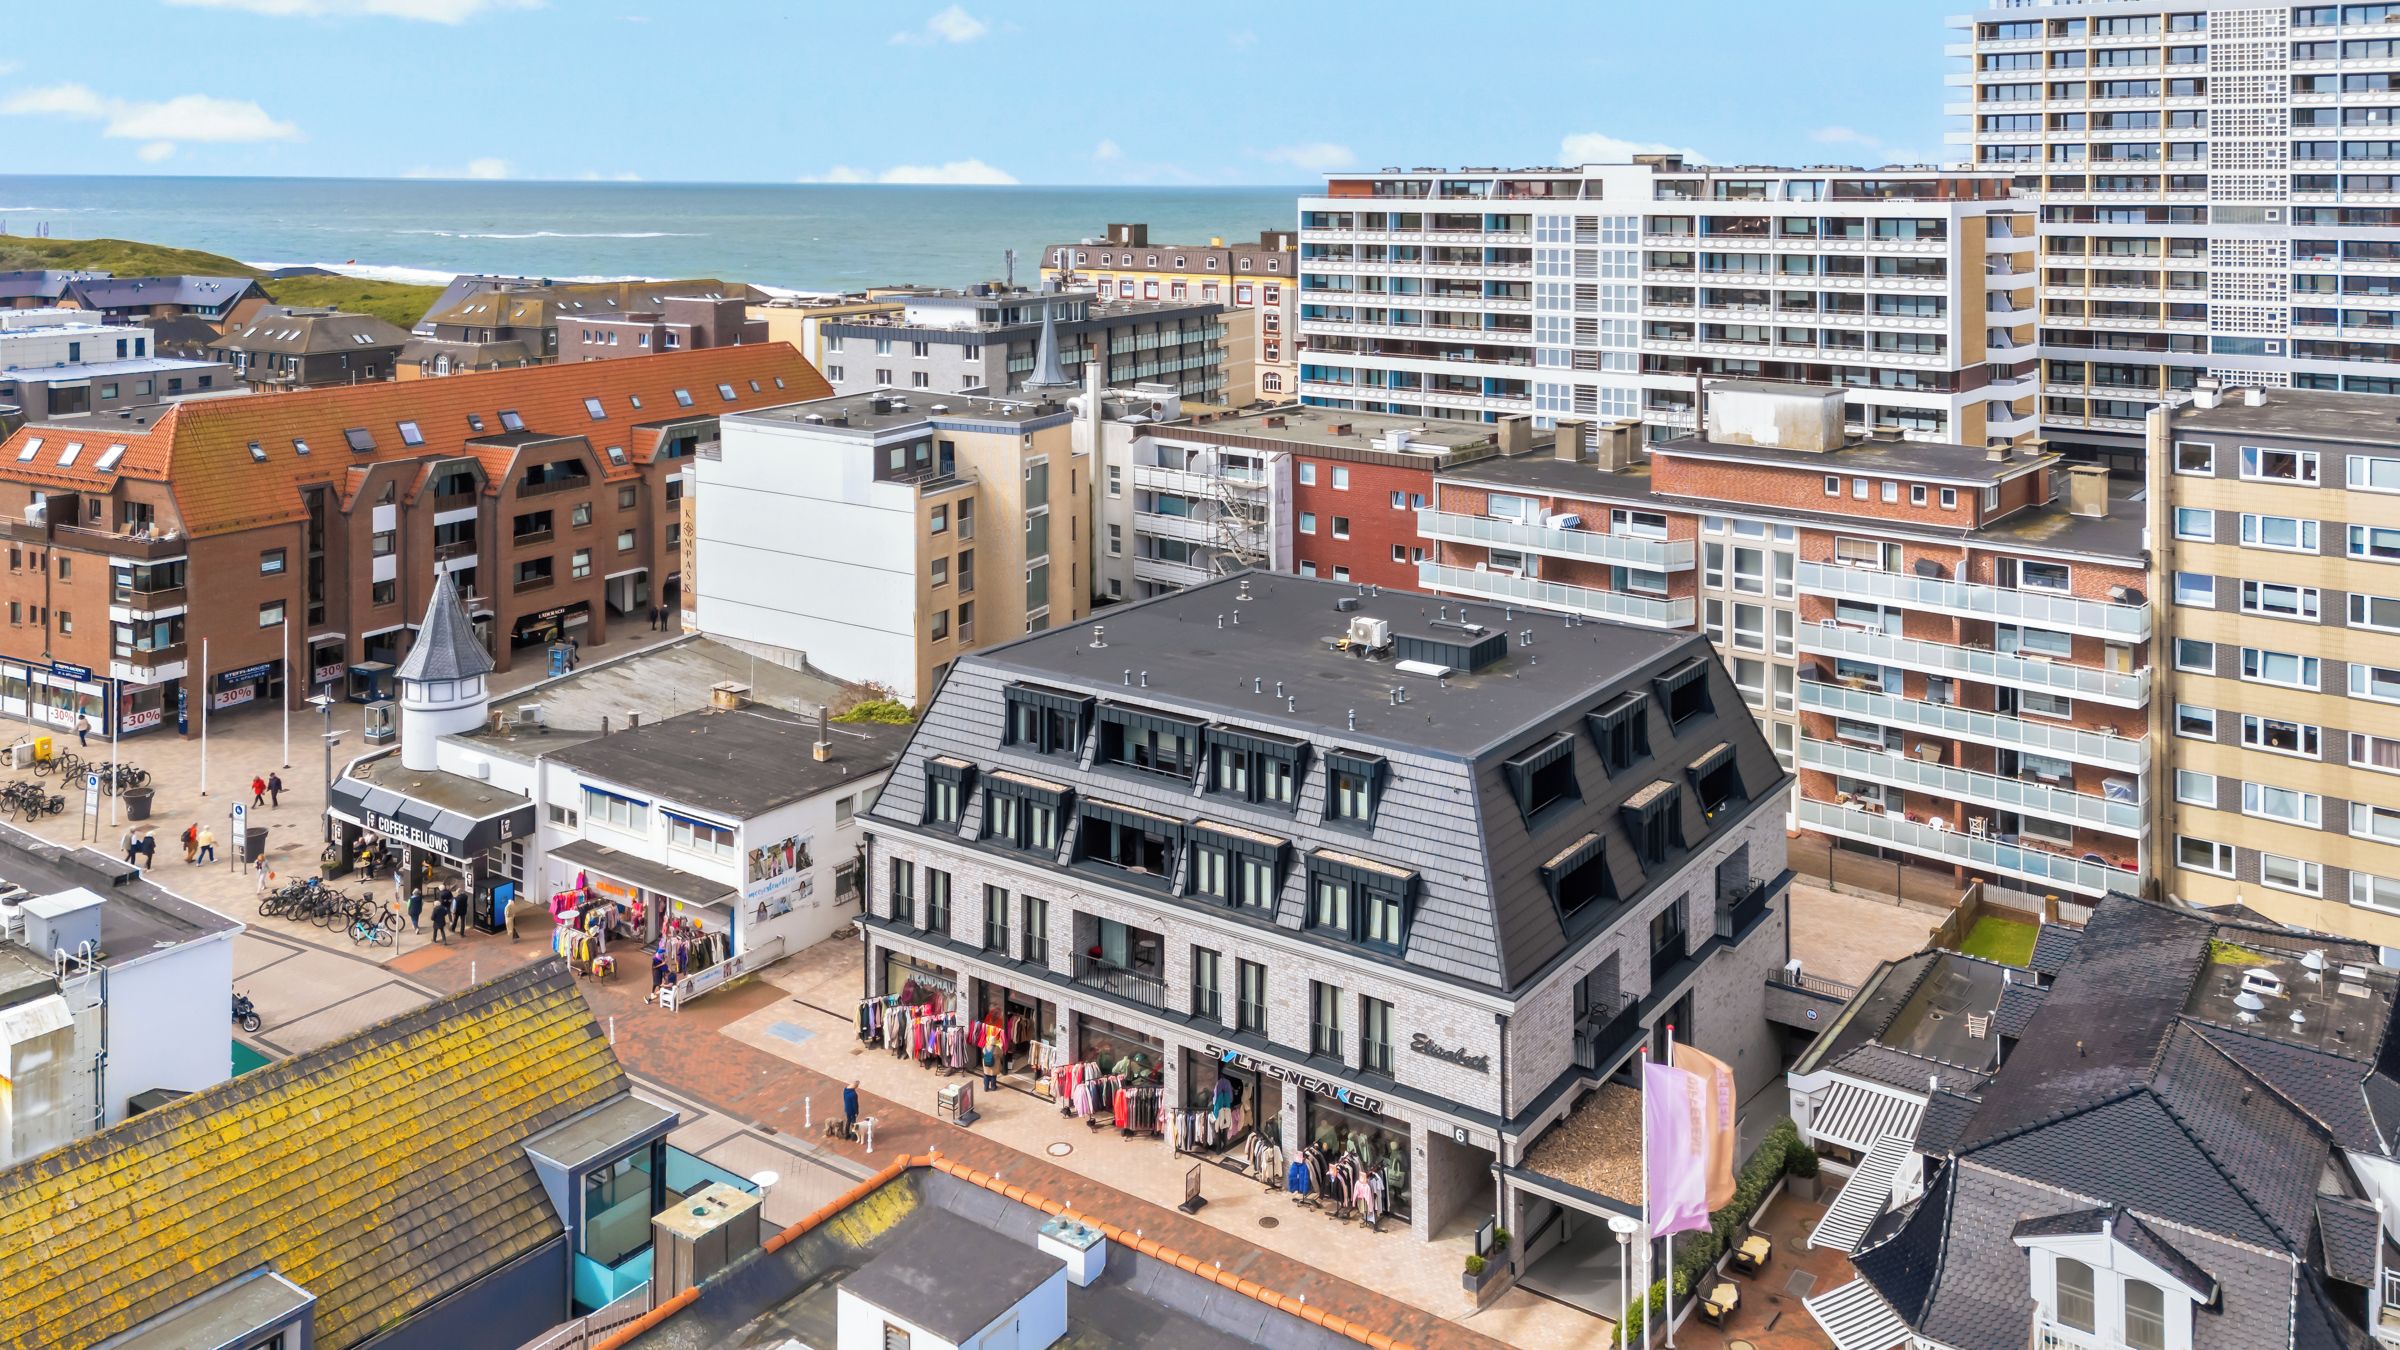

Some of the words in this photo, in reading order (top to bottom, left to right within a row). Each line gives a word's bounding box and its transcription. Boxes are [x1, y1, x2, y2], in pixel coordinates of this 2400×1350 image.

[217, 688, 252, 703] -30%
[51, 708, 74, 723] -30%
[122, 710, 160, 727] -30%
[378, 816, 409, 839] COFFEE
[410, 828, 449, 853] FELLOWS
[1203, 1043, 1262, 1072] SYLT
[1267, 1064, 1383, 1115] SNEAKER
[1455, 1128, 1465, 1143] 6
